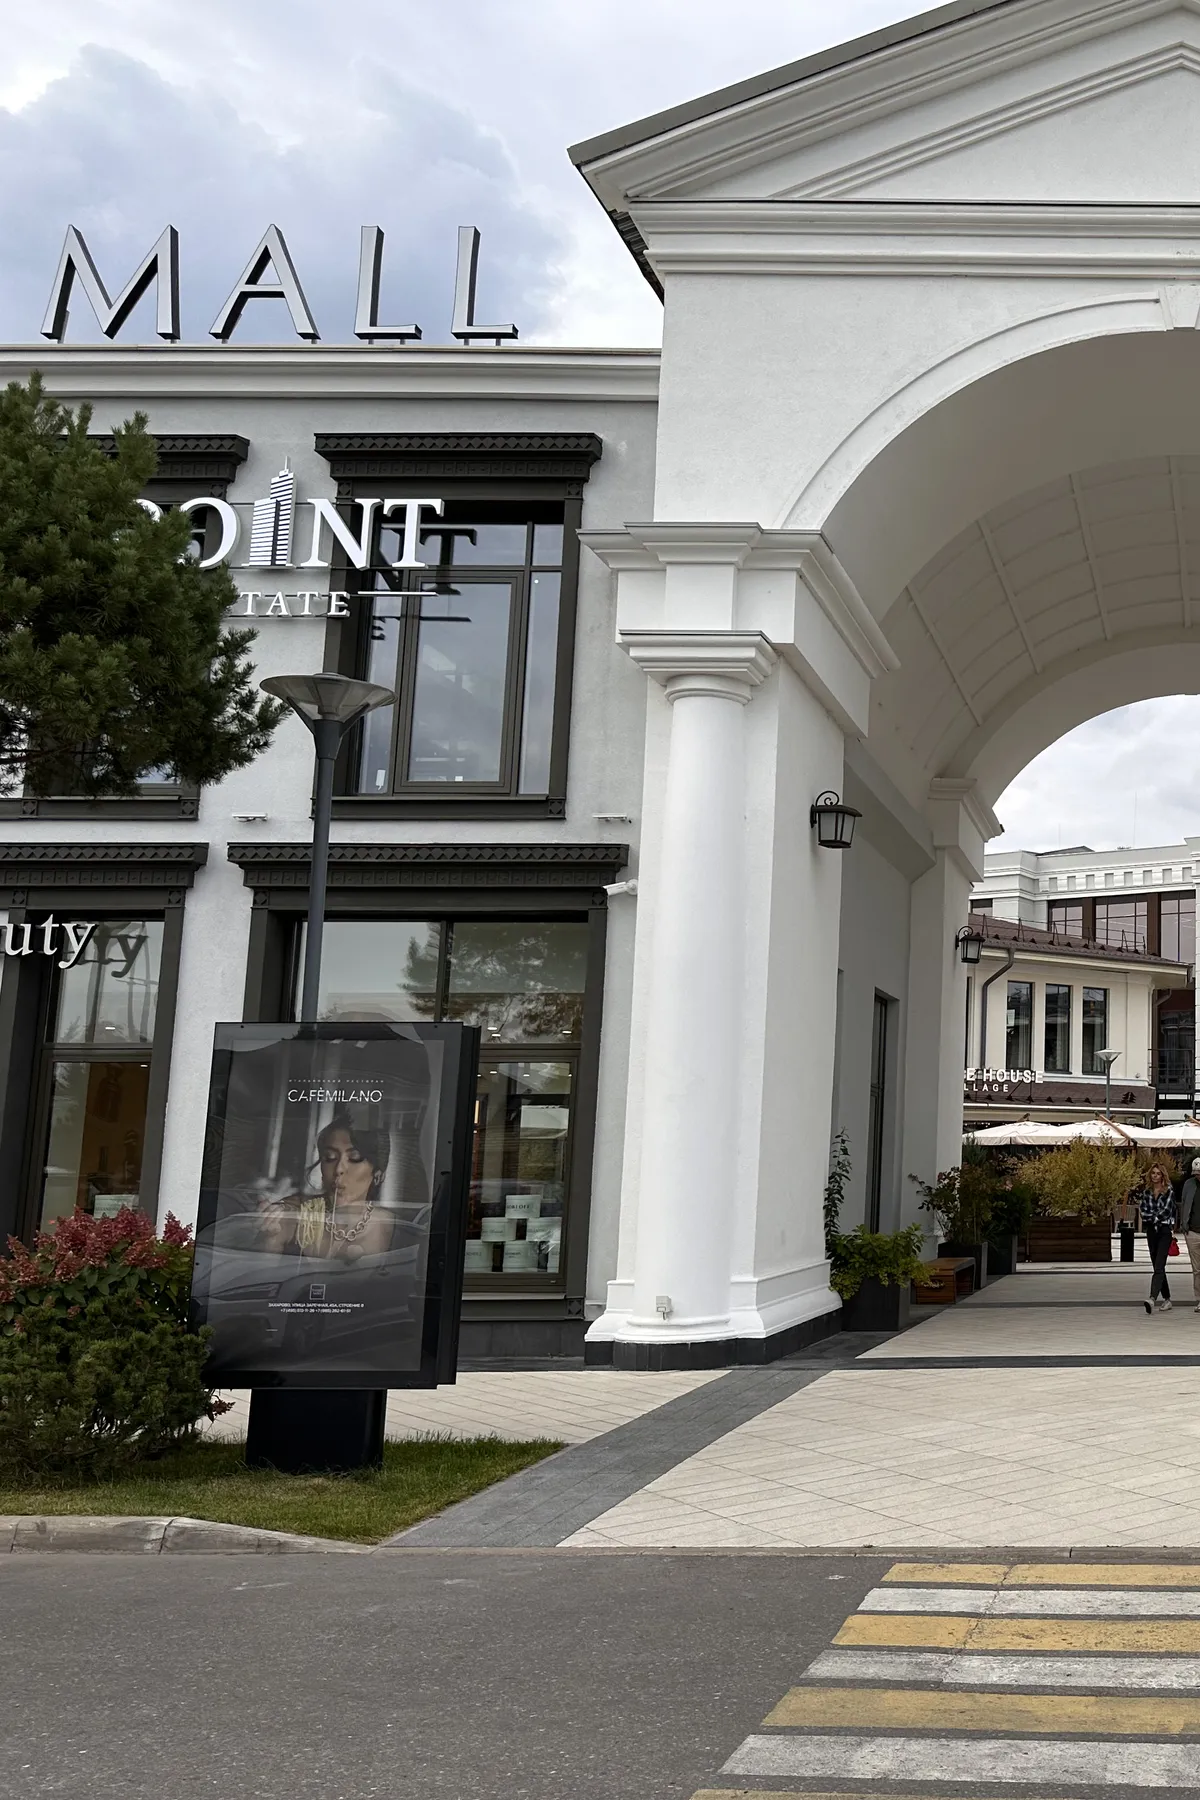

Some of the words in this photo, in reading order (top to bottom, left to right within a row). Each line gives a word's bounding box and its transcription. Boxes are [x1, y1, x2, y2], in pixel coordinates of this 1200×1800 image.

[40, 224, 519, 340] MALL
[1, 914, 96, 969] uty
[983, 1068, 1044, 1084] HOUSE
